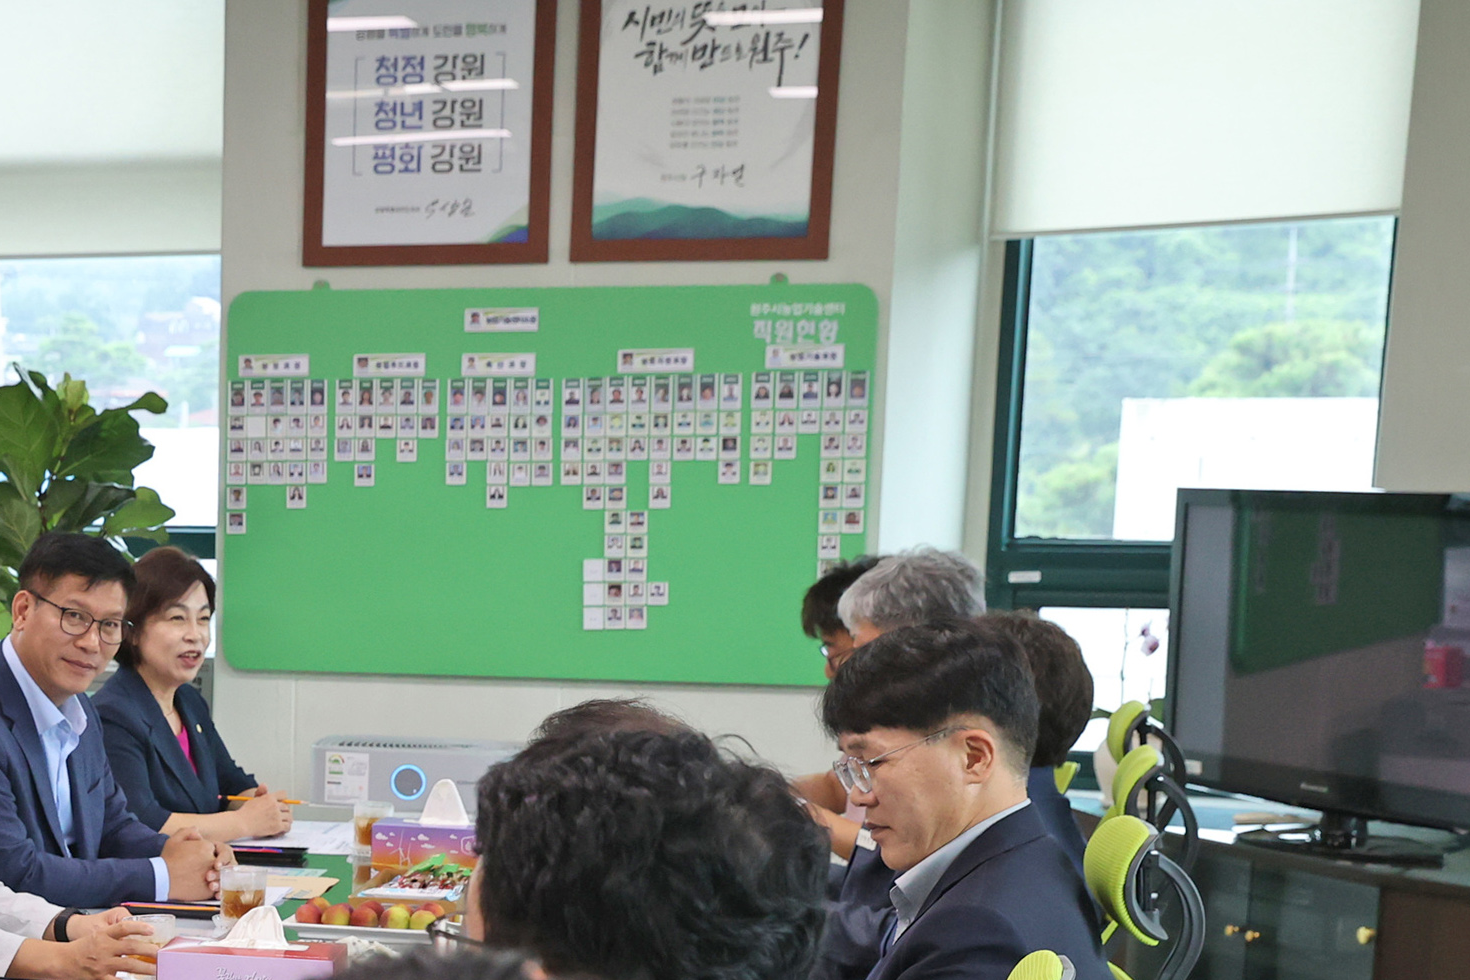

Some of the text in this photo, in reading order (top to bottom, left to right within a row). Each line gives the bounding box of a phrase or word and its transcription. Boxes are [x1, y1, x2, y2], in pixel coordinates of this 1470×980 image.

[375, 53, 485, 86] 청정 강원
[374, 98, 483, 131] 청년 강원
[372, 143, 482, 175] 평화 강원
[753, 319, 839, 344] 직원현황
